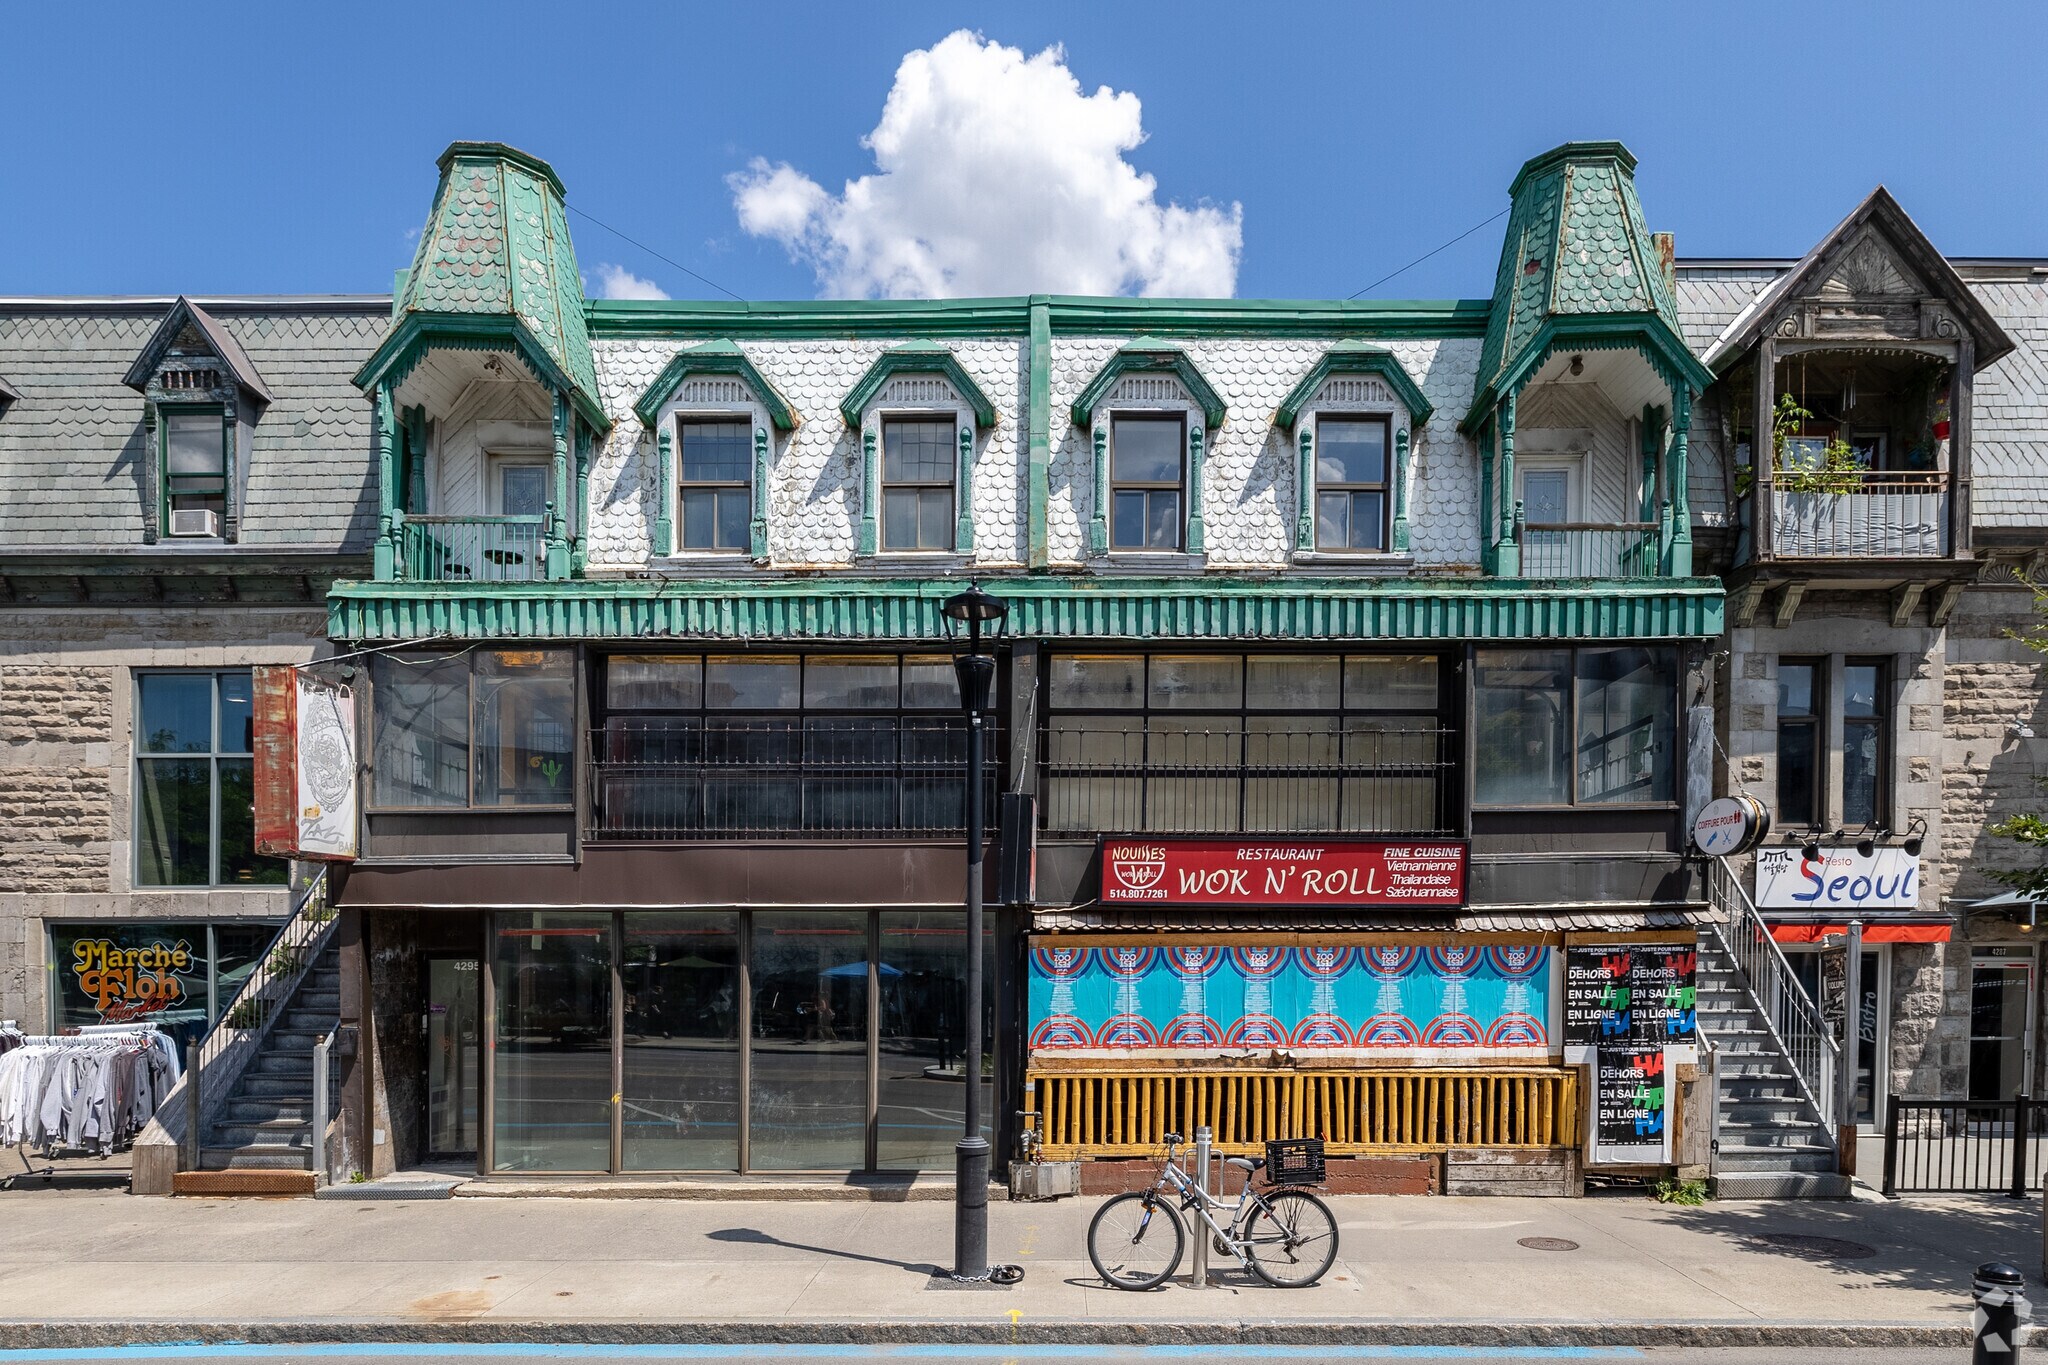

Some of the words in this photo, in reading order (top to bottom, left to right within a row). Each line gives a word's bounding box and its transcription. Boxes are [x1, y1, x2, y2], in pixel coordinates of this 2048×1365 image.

[1698, 818, 1720, 830] COIFFURE
[1720, 815, 1733, 825] POUR
[1236, 849, 1324, 860] RESTAURANT
[1383, 848, 1411, 858] FINE
[1414, 848, 1461, 857] CUISINE
[1387, 861, 1457, 871] Vietnamienne
[1825, 856, 1852, 866] Resto
[1178, 869, 1250, 896] WOK
[1302, 867, 1382, 896] ROLL
[1791, 854, 1915, 902] Seoul
[1110, 889, 1168, 898] 514.807.7261
[1385, 886, 1459, 897] Széchuannaise
[74, 941, 188, 977] Marché
[454, 962, 478, 971] 4295
[1568, 969, 1611, 979] DEHORS
[1632, 969, 1675, 978] DEHORS
[81, 967, 180, 1011] Floh
[1632, 989, 1646, 998] EN
[1649, 989, 1681, 998] SALLE
[1568, 990, 1582, 999] EN
[1584, 990, 1617, 999] SALLE
[101, 992, 172, 1025] Market
[1568, 1010, 1582, 1019] EN
[1584, 1010, 1615, 1019] LIGNE
[1632, 1010, 1646, 1019] EN
[1649, 1009, 1681, 1018] LIGNE
[1860, 992, 1877, 1043] Bistro
[1600, 1069, 1644, 1078] DEHORS
[1600, 1089, 1614, 1098] EN
[1617, 1089, 1650, 1098] SALLE
[1600, 1109, 1614, 1119] EN
[1617, 1109, 1649, 1119] LIGNE
[1711, 1139, 1719, 1155] 9
